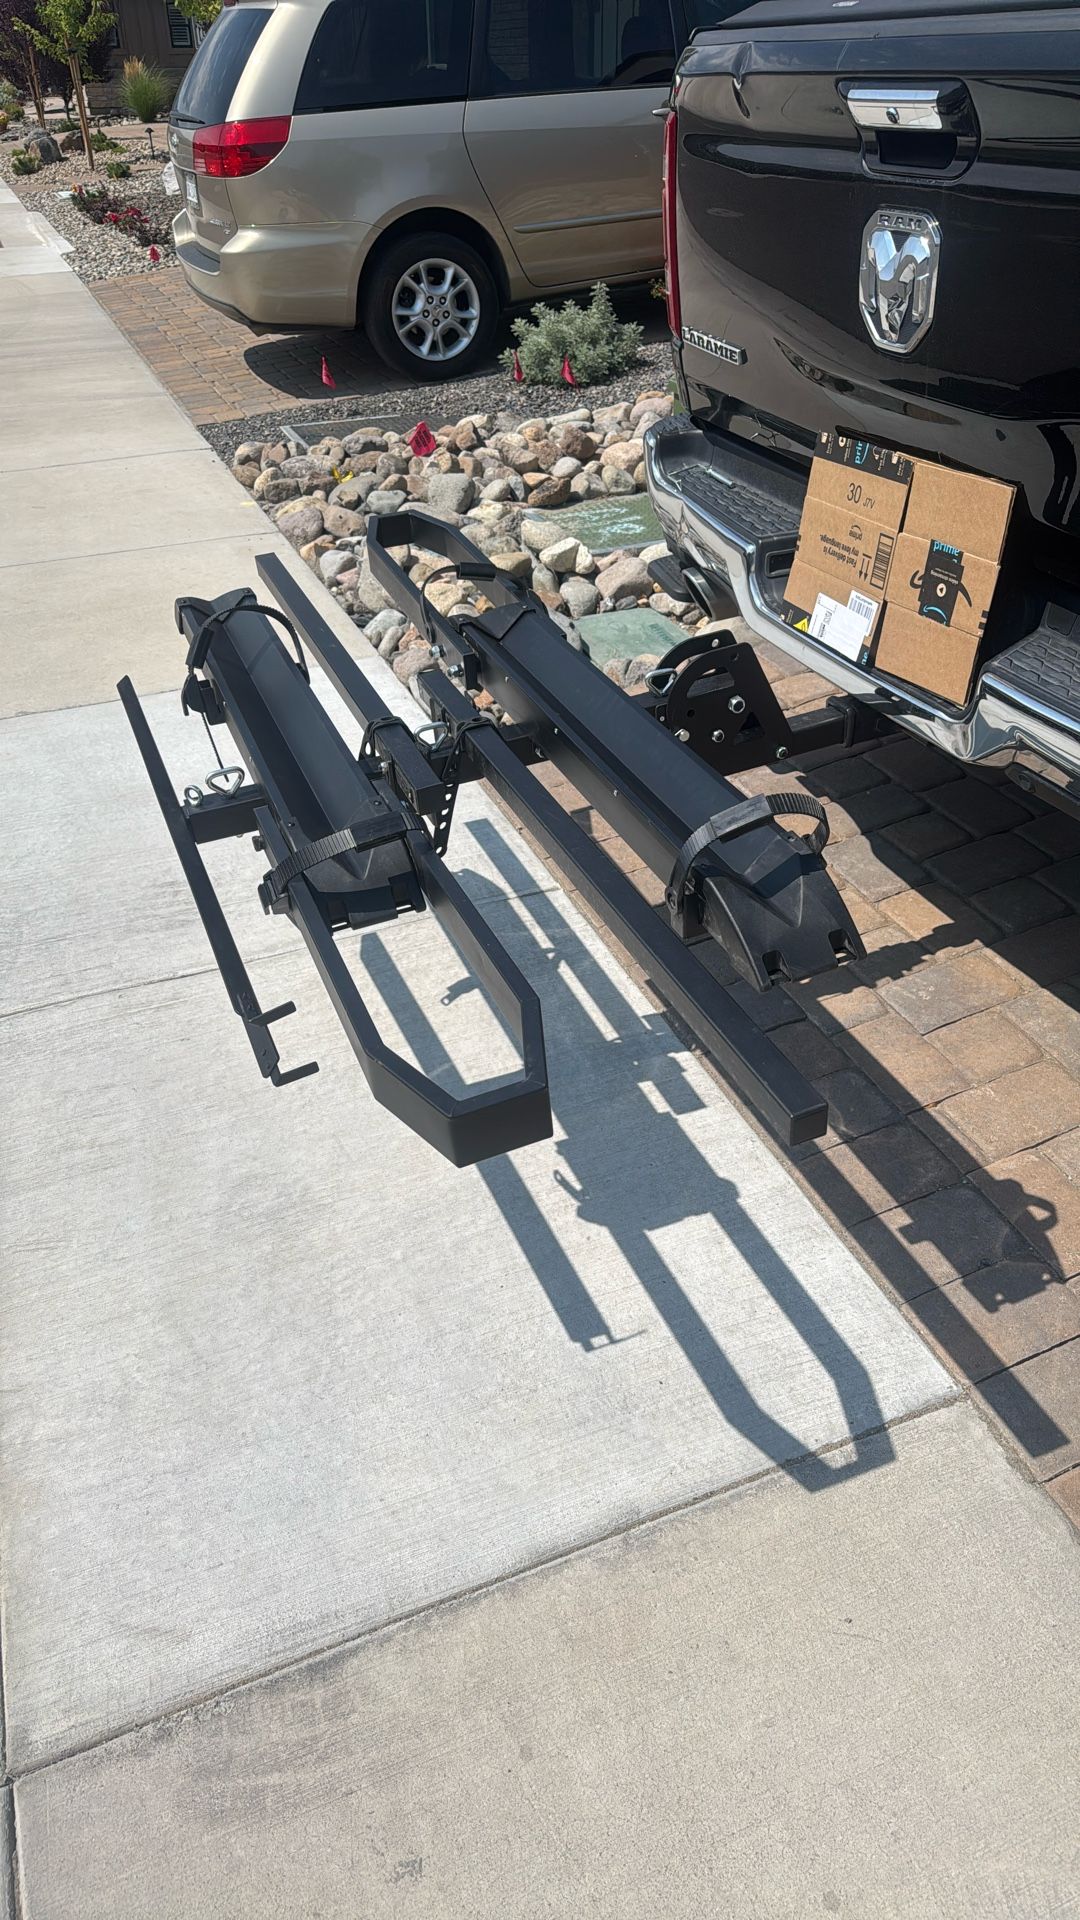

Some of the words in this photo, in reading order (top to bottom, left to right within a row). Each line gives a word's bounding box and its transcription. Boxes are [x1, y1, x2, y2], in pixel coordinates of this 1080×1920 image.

[877, 212, 922, 231] RAM
[682, 327, 738, 363] LARAMIE
[847, 482, 862, 504] 30
[933, 540, 960, 557] prime
